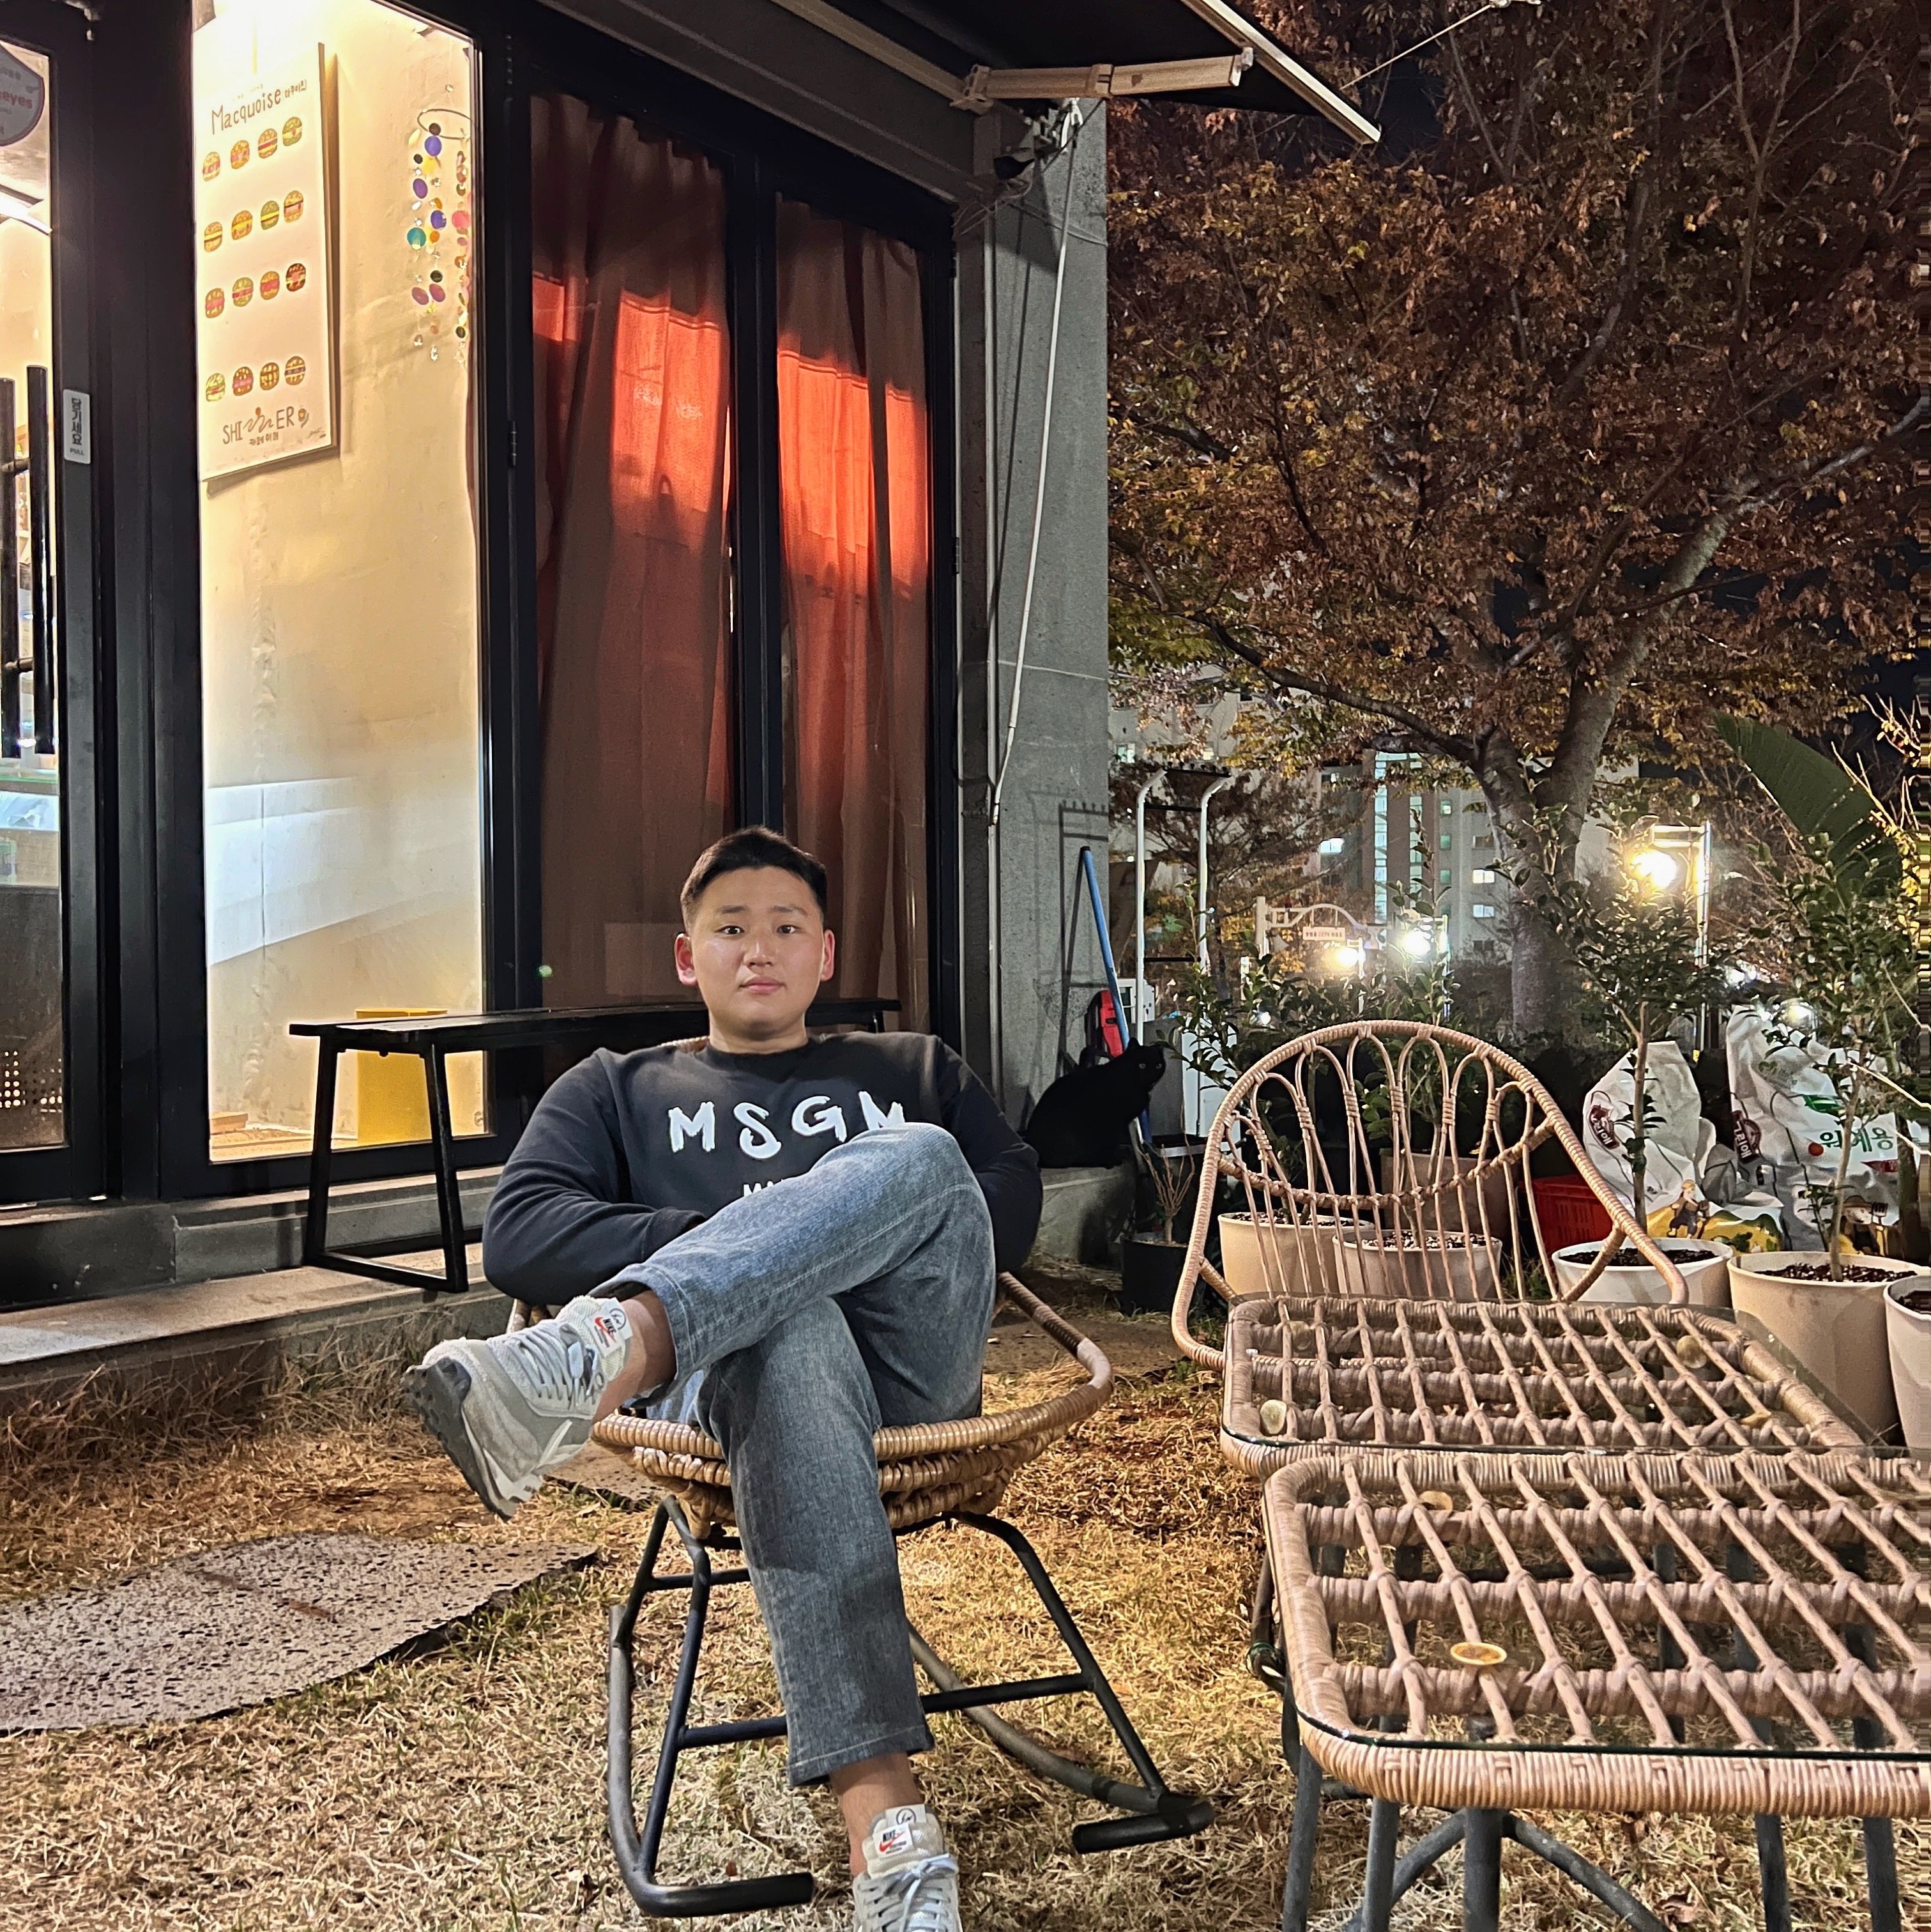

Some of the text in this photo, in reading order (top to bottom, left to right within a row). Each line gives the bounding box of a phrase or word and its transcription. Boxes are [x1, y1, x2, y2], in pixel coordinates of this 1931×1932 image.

[0, 91, 33, 109] eyes
[211, 89, 281, 135] Macquoise
[71, 397, 82, 445] 당기세요
[1820, 1127, 1893, 1152] 원예용
[602, 1318, 617, 1334] NIKE
[883, 1829, 897, 1843] NIKE
